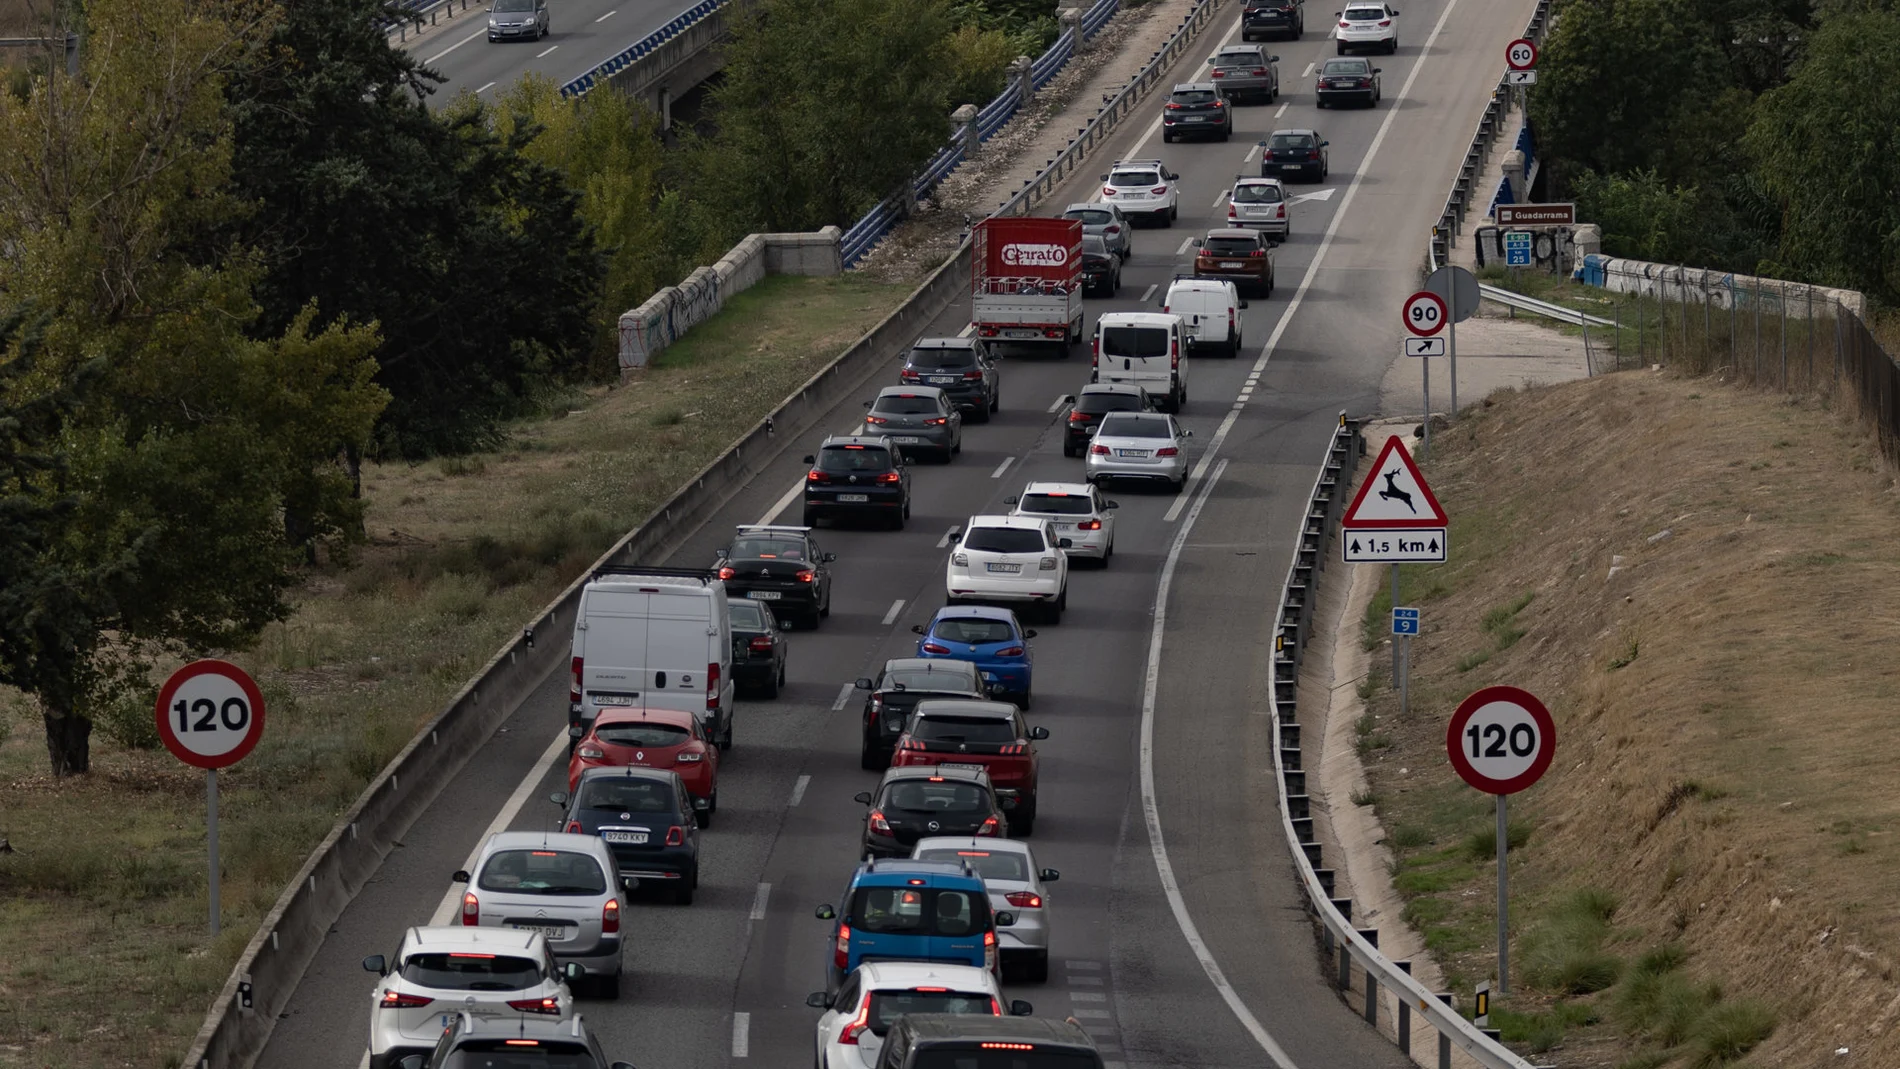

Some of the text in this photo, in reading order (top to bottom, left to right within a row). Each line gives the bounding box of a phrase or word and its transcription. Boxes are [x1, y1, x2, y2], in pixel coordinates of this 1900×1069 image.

[1512, 49, 1531, 61] 60
[1515, 211, 1570, 221] Guadarrama
[1513, 255, 1524, 263] 25
[1411, 306, 1438, 322] 90
[1368, 538, 1426, 555] 1,5 km
[1401, 621, 1410, 632] 9
[173, 697, 251, 733] 120
[1466, 722, 1536, 759] 120
[608, 832, 647, 842] 9740 KKY
